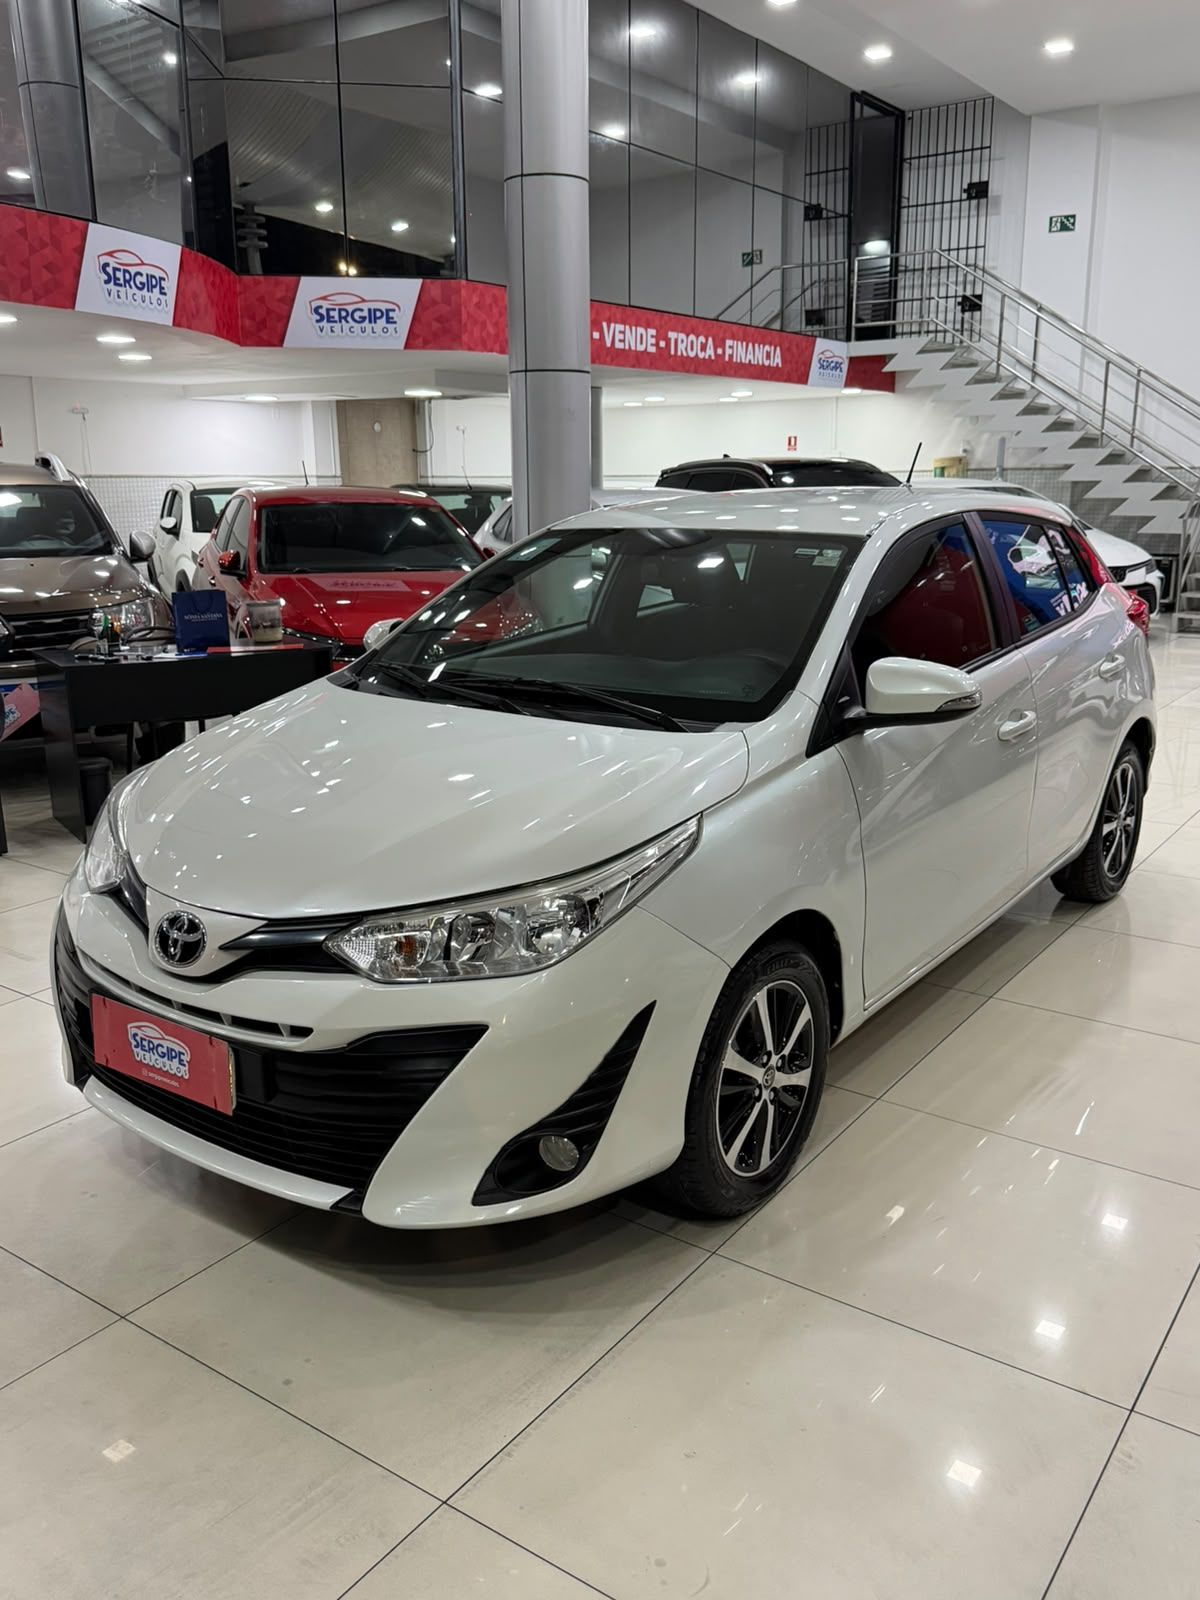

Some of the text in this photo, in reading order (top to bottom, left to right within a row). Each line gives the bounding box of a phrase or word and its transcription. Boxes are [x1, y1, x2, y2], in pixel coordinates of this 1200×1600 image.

[101, 262, 167, 296] SERGIPE
[313, 305, 397, 324] SERGIPE
[602, 321, 656, 353] VENDE
[668, 330, 715, 360] TROCA
[725, 339, 782, 368] FINANCIA
[132, 1032, 186, 1068] SERGIPE
